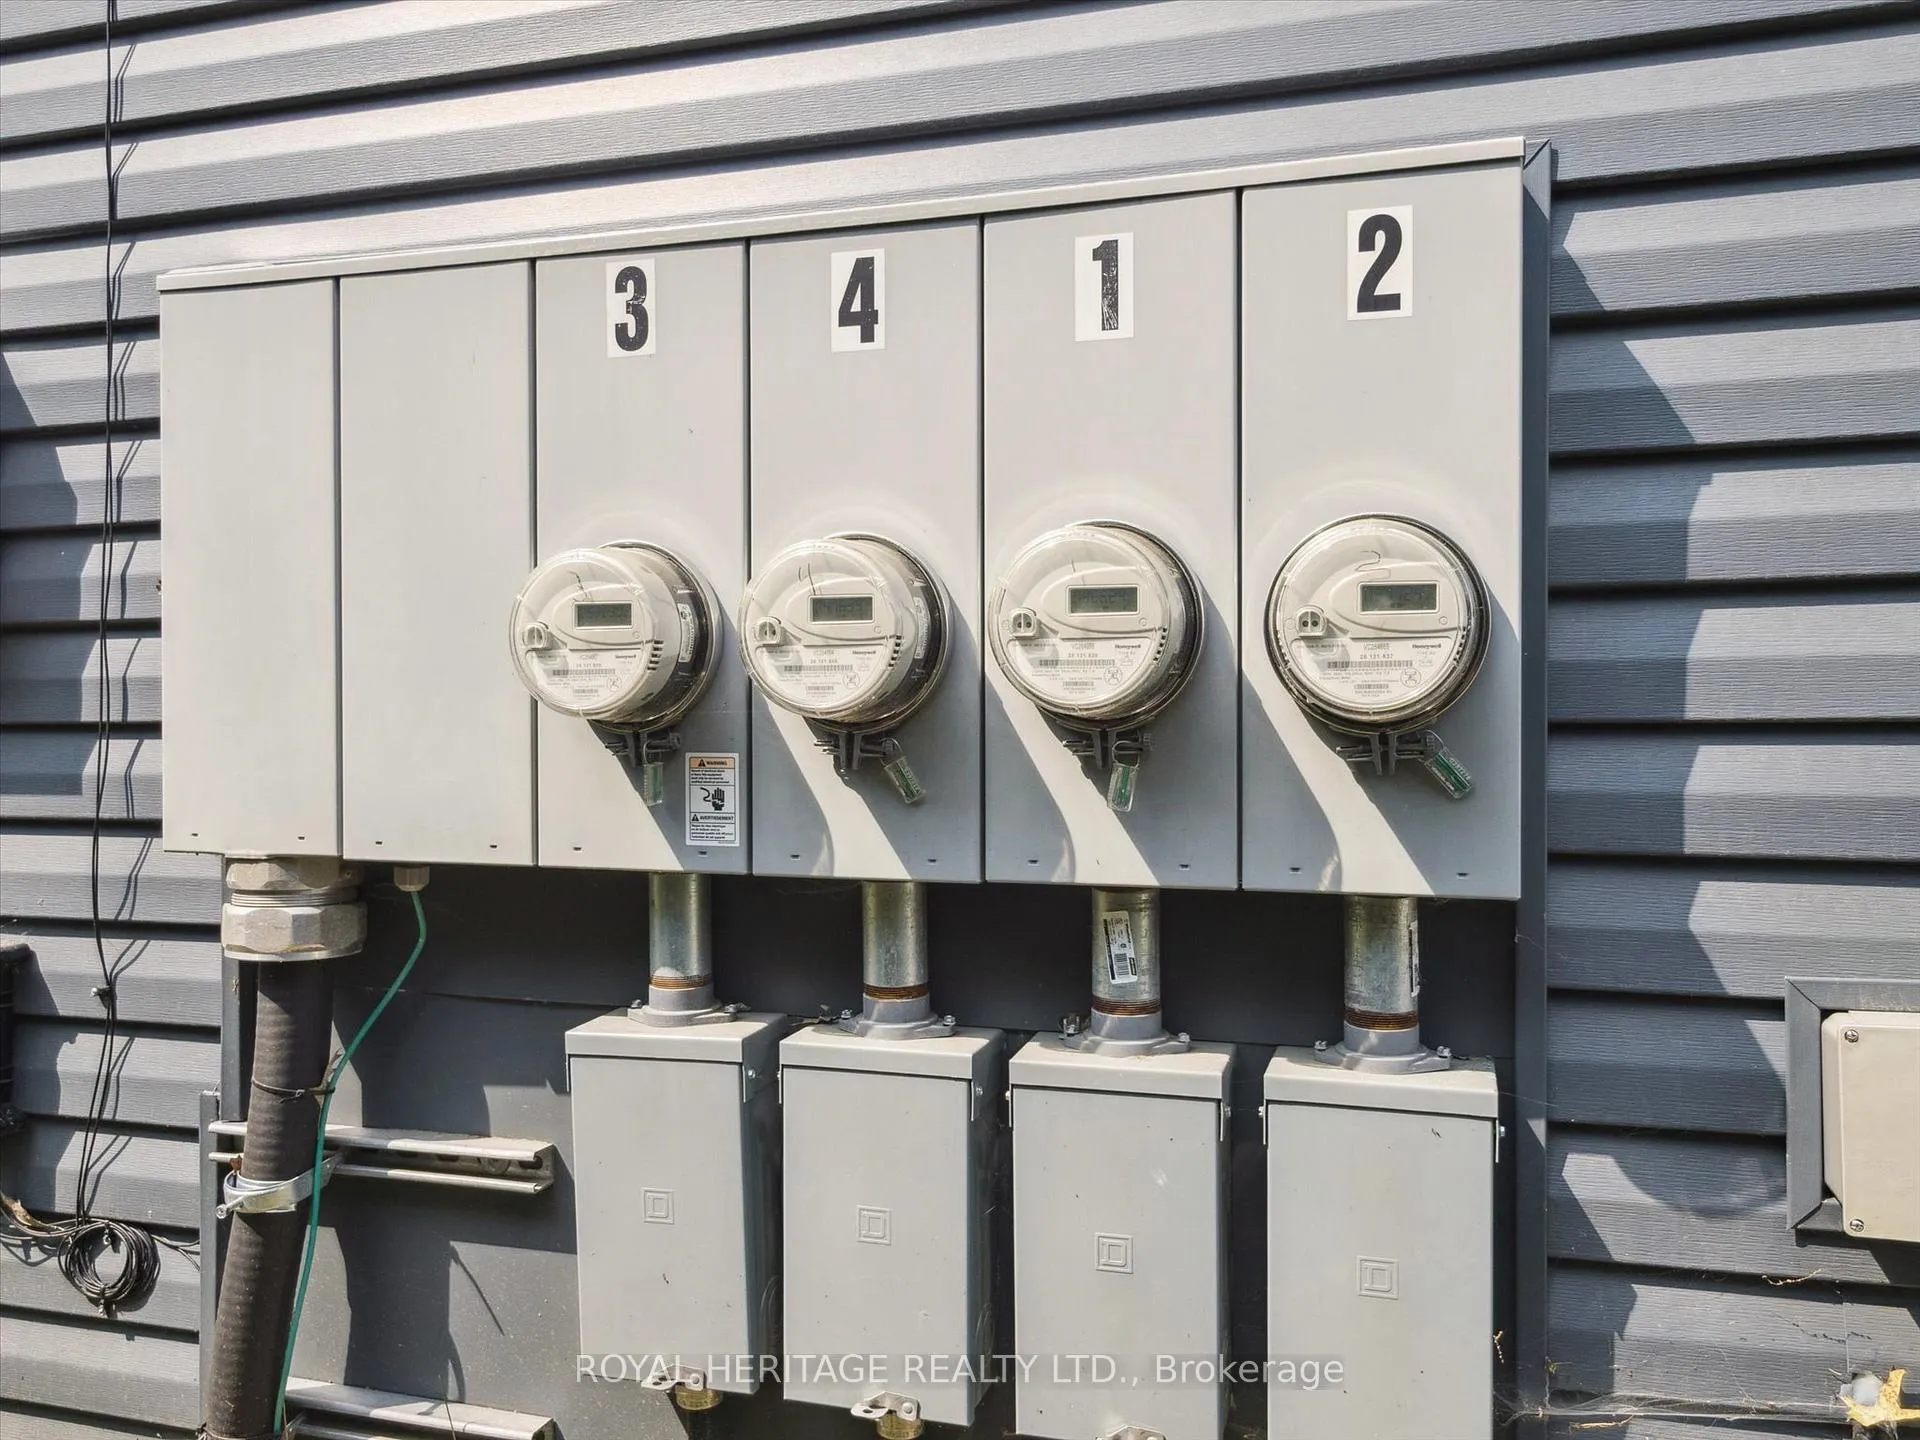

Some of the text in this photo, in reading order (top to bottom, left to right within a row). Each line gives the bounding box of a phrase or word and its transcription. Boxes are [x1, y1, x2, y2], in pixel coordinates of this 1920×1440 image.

[838, 256, 879, 343] 4
[1092, 239, 1120, 331] 1
[1357, 213, 1402, 313] 2
[615, 266, 648, 351] 3
